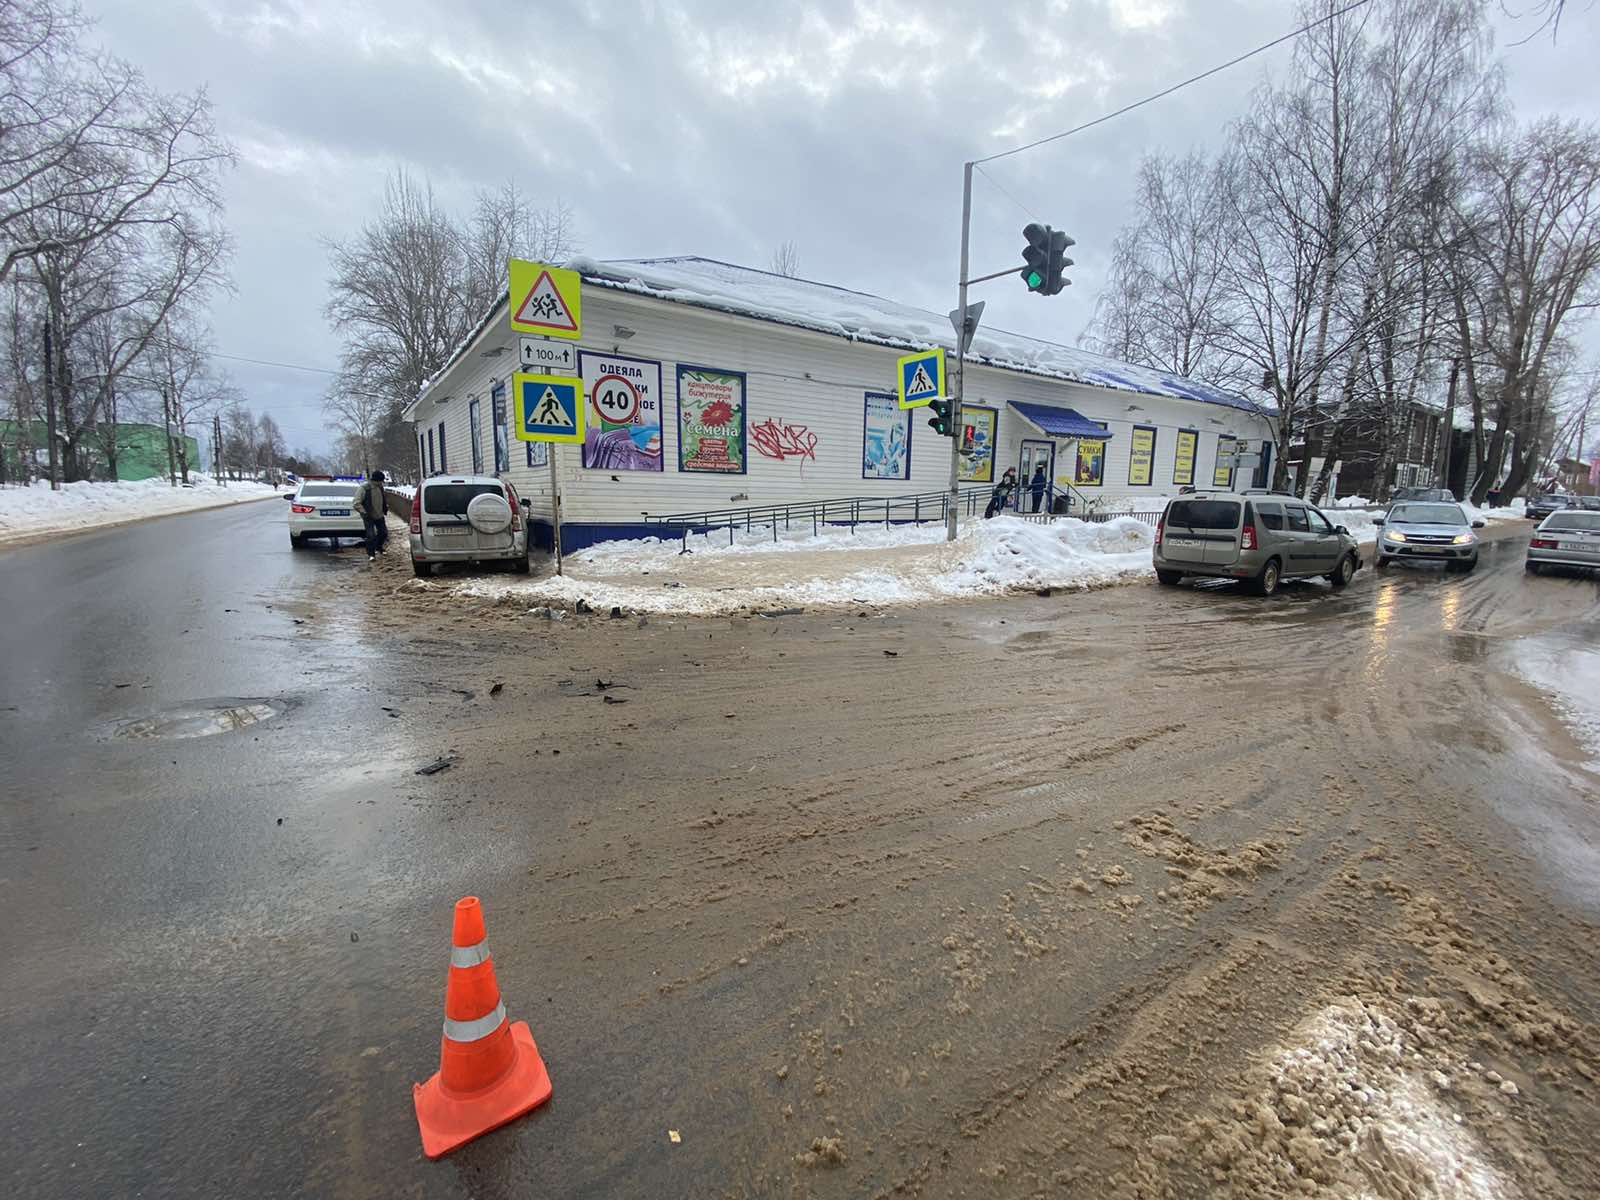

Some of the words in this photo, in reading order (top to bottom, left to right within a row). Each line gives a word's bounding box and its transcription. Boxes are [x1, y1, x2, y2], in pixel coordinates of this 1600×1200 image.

[536, 349, 554, 360] 100
[600, 364, 643, 378] ОДЕЯЛА
[601, 389, 629, 410] 40
[688, 388, 732, 400] бижутерия
[687, 424, 739, 436] семена
